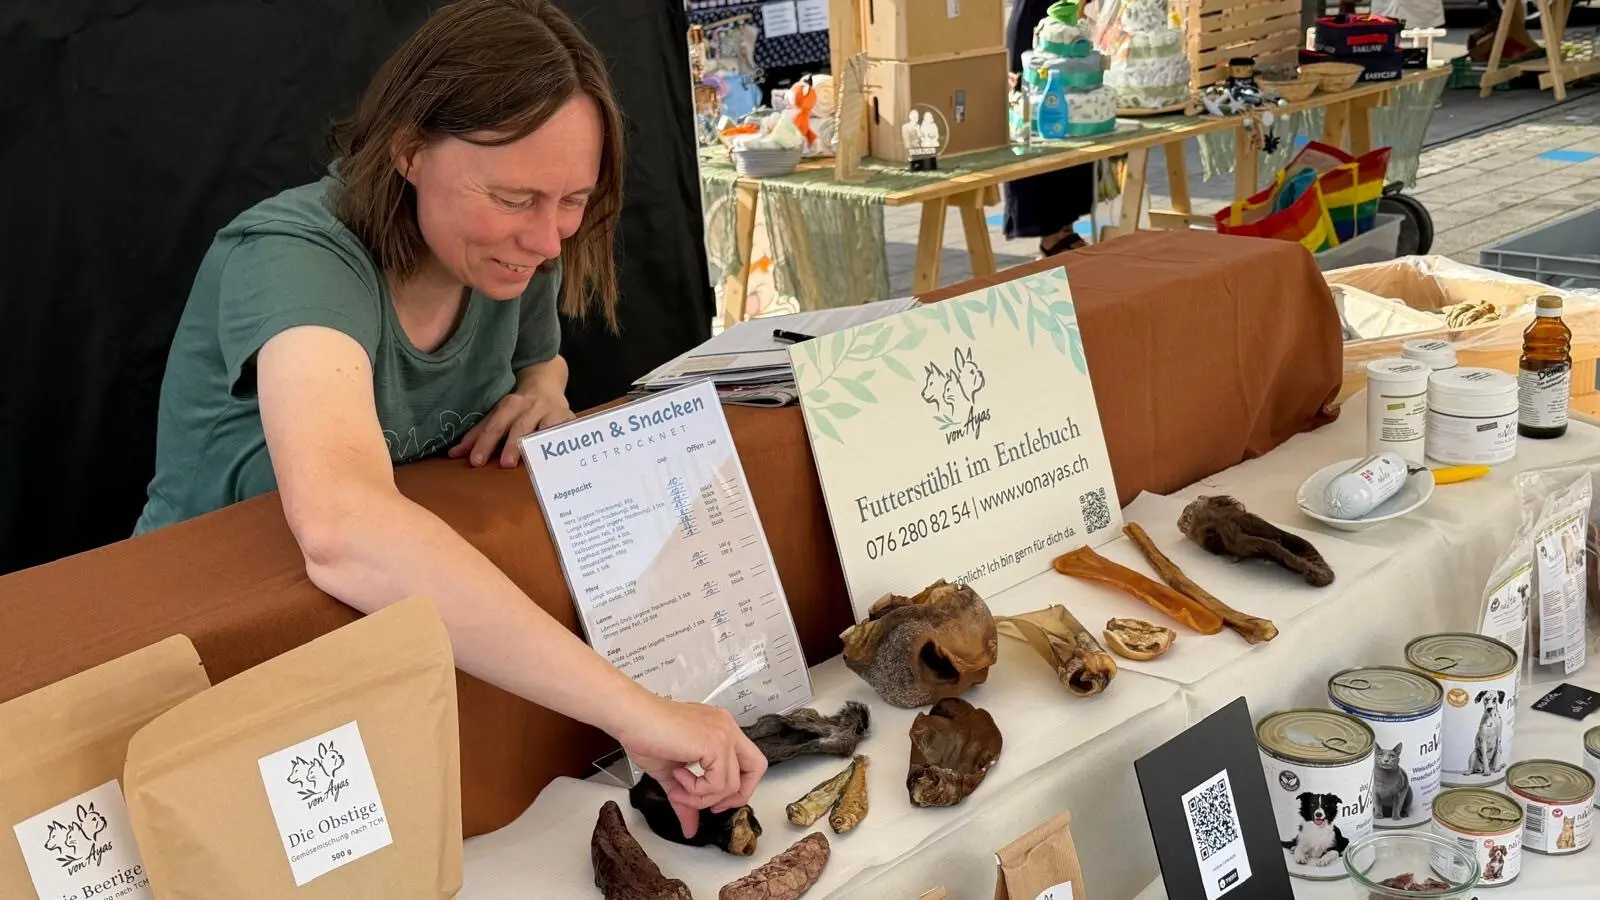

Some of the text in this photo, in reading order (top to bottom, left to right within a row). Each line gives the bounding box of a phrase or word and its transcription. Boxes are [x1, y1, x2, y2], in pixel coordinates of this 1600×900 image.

[540, 396, 705, 460] Kauen & Snacken
[945, 405, 991, 445] von Ayas
[854, 416, 1082, 523] Futterstübli im Entlebuch
[553, 481, 593, 501] Abgepackt
[866, 531, 897, 560] 076
[899, 519, 928, 547] 280
[930, 510, 950, 533] 82
[951, 500, 971, 524] 54
[979, 454, 1089, 513] www.vonayas.ch
[986, 556, 1000, 575] Ich
[999, 551, 1015, 568] bin
[1014, 543, 1034, 564] gern
[1033, 535, 1047, 552] für
[1046, 527, 1065, 547] dich
[1063, 526, 1077, 540] da.
[307, 778, 350, 810] von Ayas
[288, 801, 378, 849] Die Obstige
[291, 816, 384, 863] Gemüsemischung nach TCM
[67, 841, 113, 876] von Ayas
[331, 848, 352, 861] 500 g
[81, 864, 143, 900] Beerige
[115, 887, 133, 899] nach
[133, 877, 150, 889] TCM
